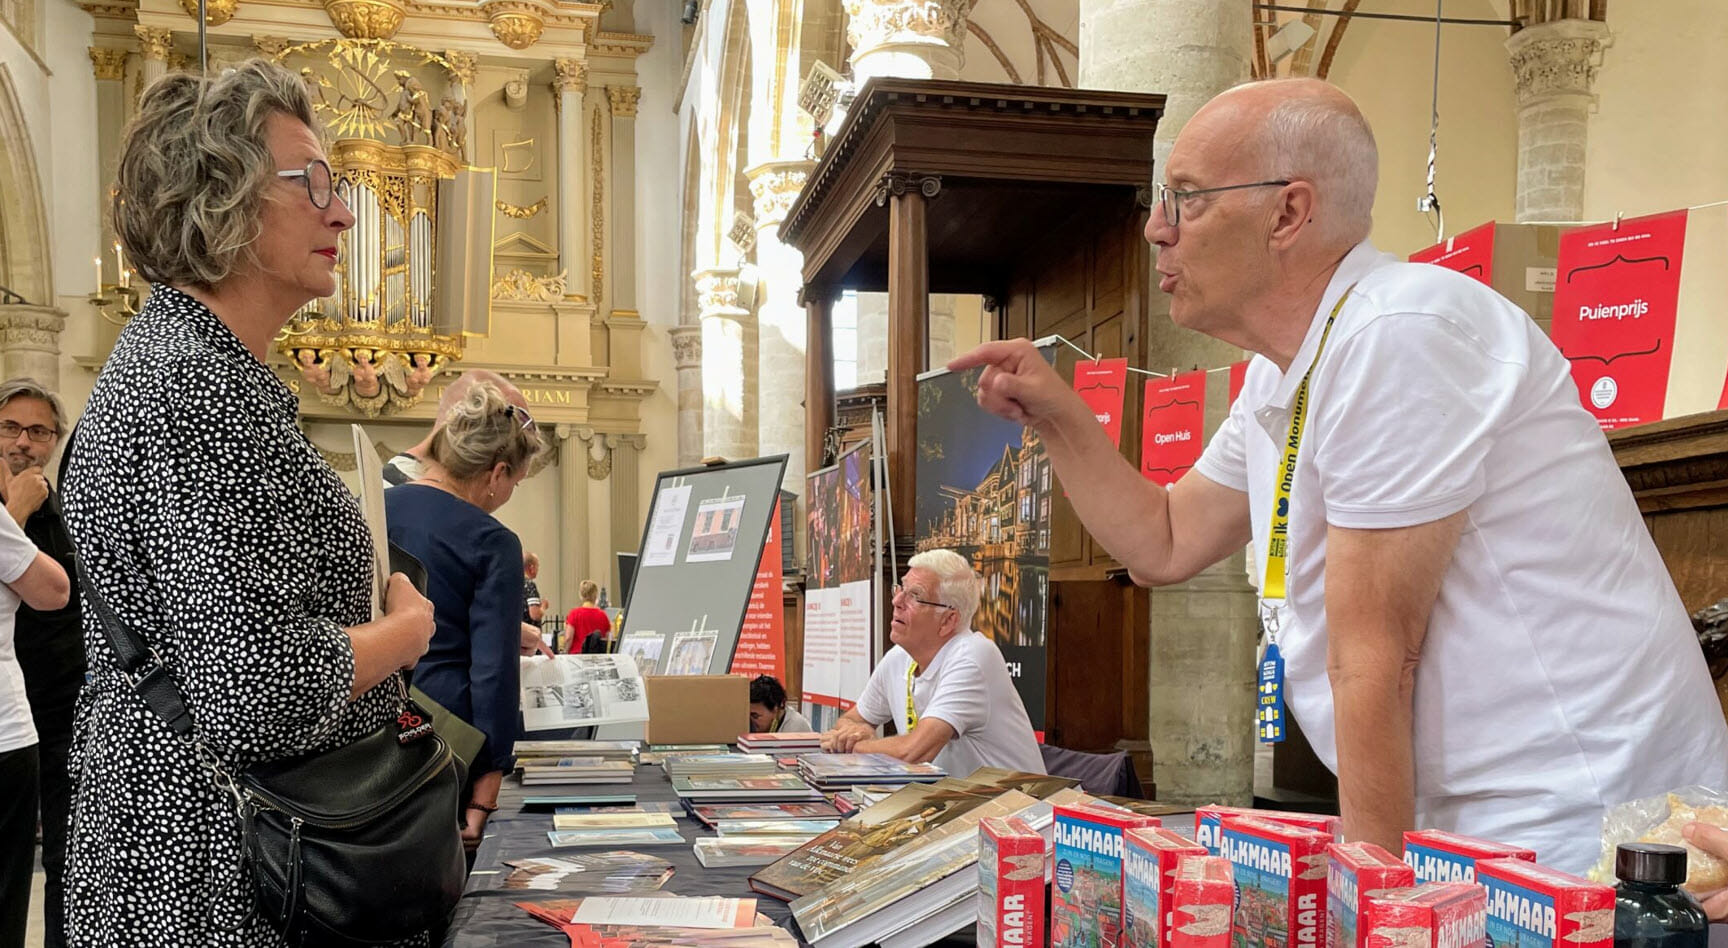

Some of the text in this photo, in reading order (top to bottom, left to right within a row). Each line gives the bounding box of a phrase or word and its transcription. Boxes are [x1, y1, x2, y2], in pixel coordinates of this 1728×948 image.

[1579, 299, 1649, 321] Puienprijs
[1154, 429, 1191, 446] Open Huis
[1275, 521, 1288, 535] Ik
[1053, 821, 1125, 859] ALKMAAR
[1220, 836, 1293, 878] ALKMAAR
[1125, 847, 1160, 893] ALKMAAR
[1003, 894, 1025, 948] AAR
[1297, 893, 1317, 948] AAR
[1477, 881, 1557, 940] LKMAAR
